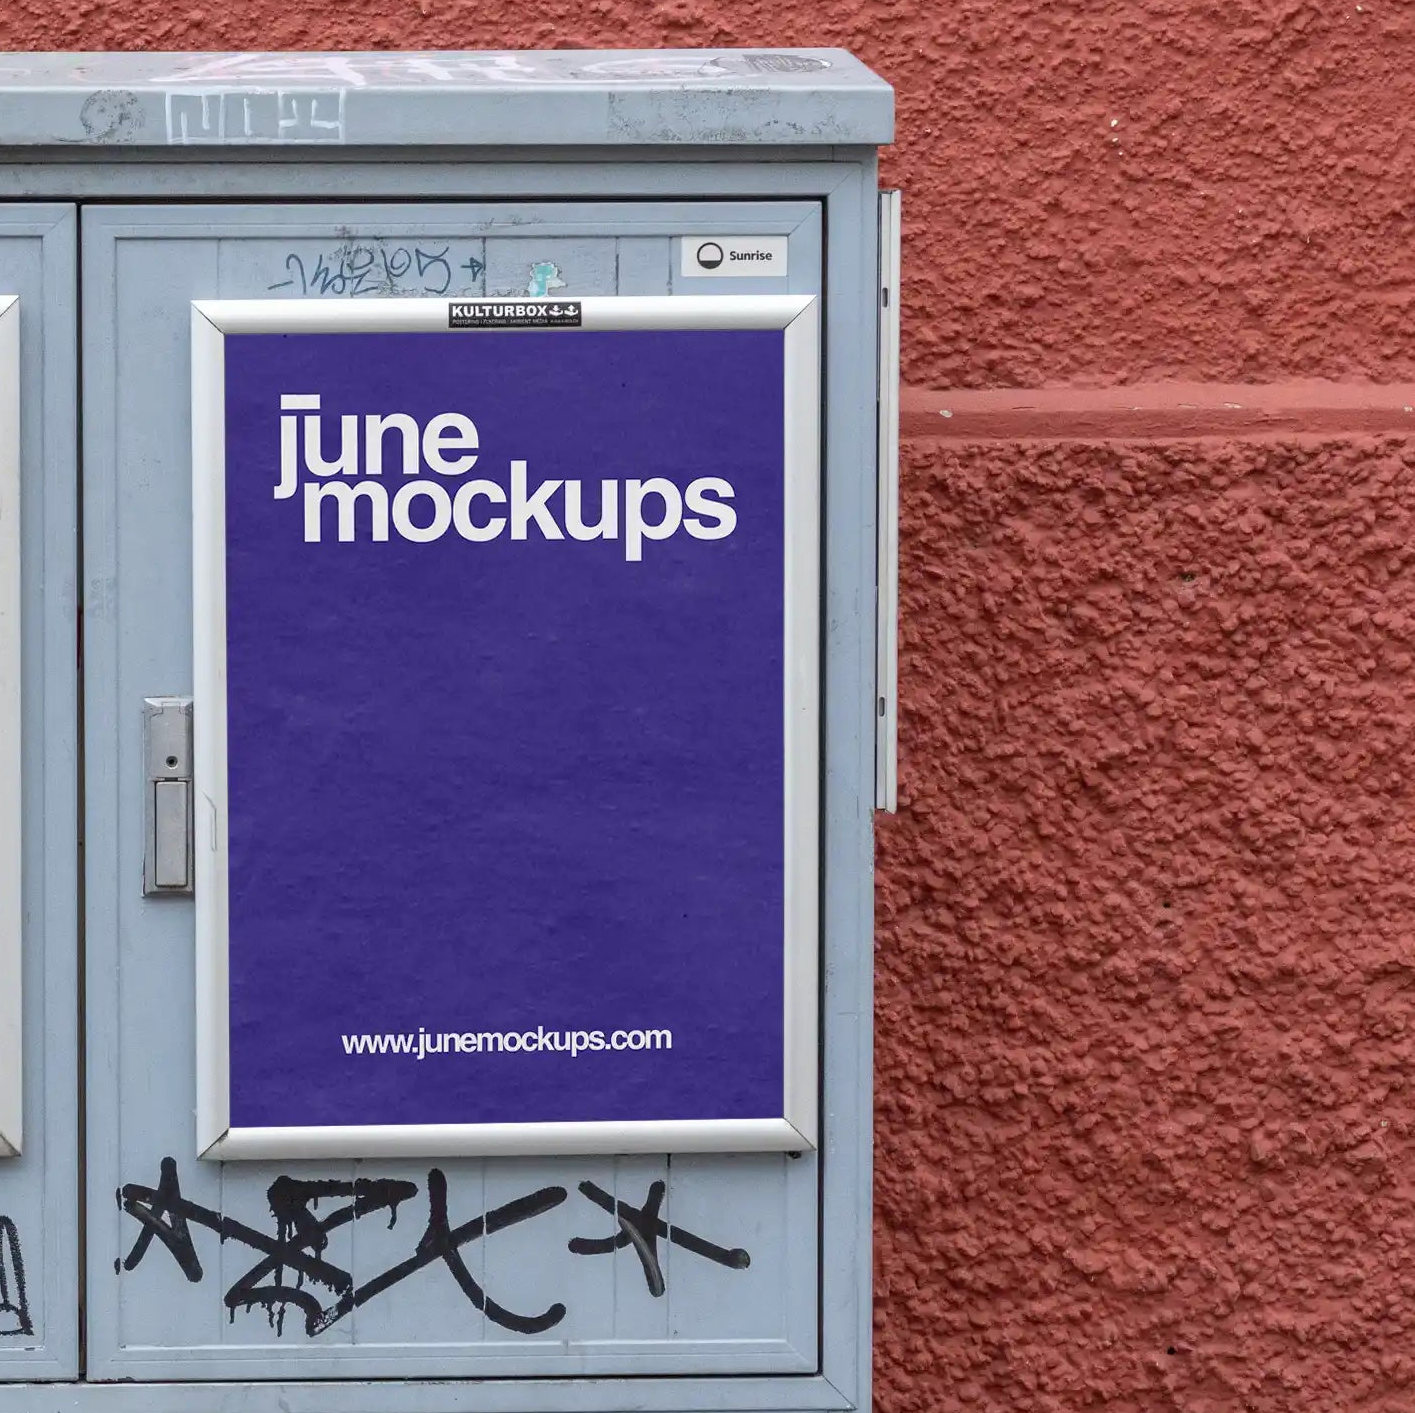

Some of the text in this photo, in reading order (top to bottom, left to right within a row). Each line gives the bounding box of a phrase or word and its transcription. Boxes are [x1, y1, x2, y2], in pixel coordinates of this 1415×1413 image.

[729, 250, 773, 261] Sunrise
[452, 305, 548, 317] KULTURBOX
[273, 394, 479, 500] june
[304, 460, 737, 562] mockups
[341, 1025, 672, 1060] www.junemockups.com
